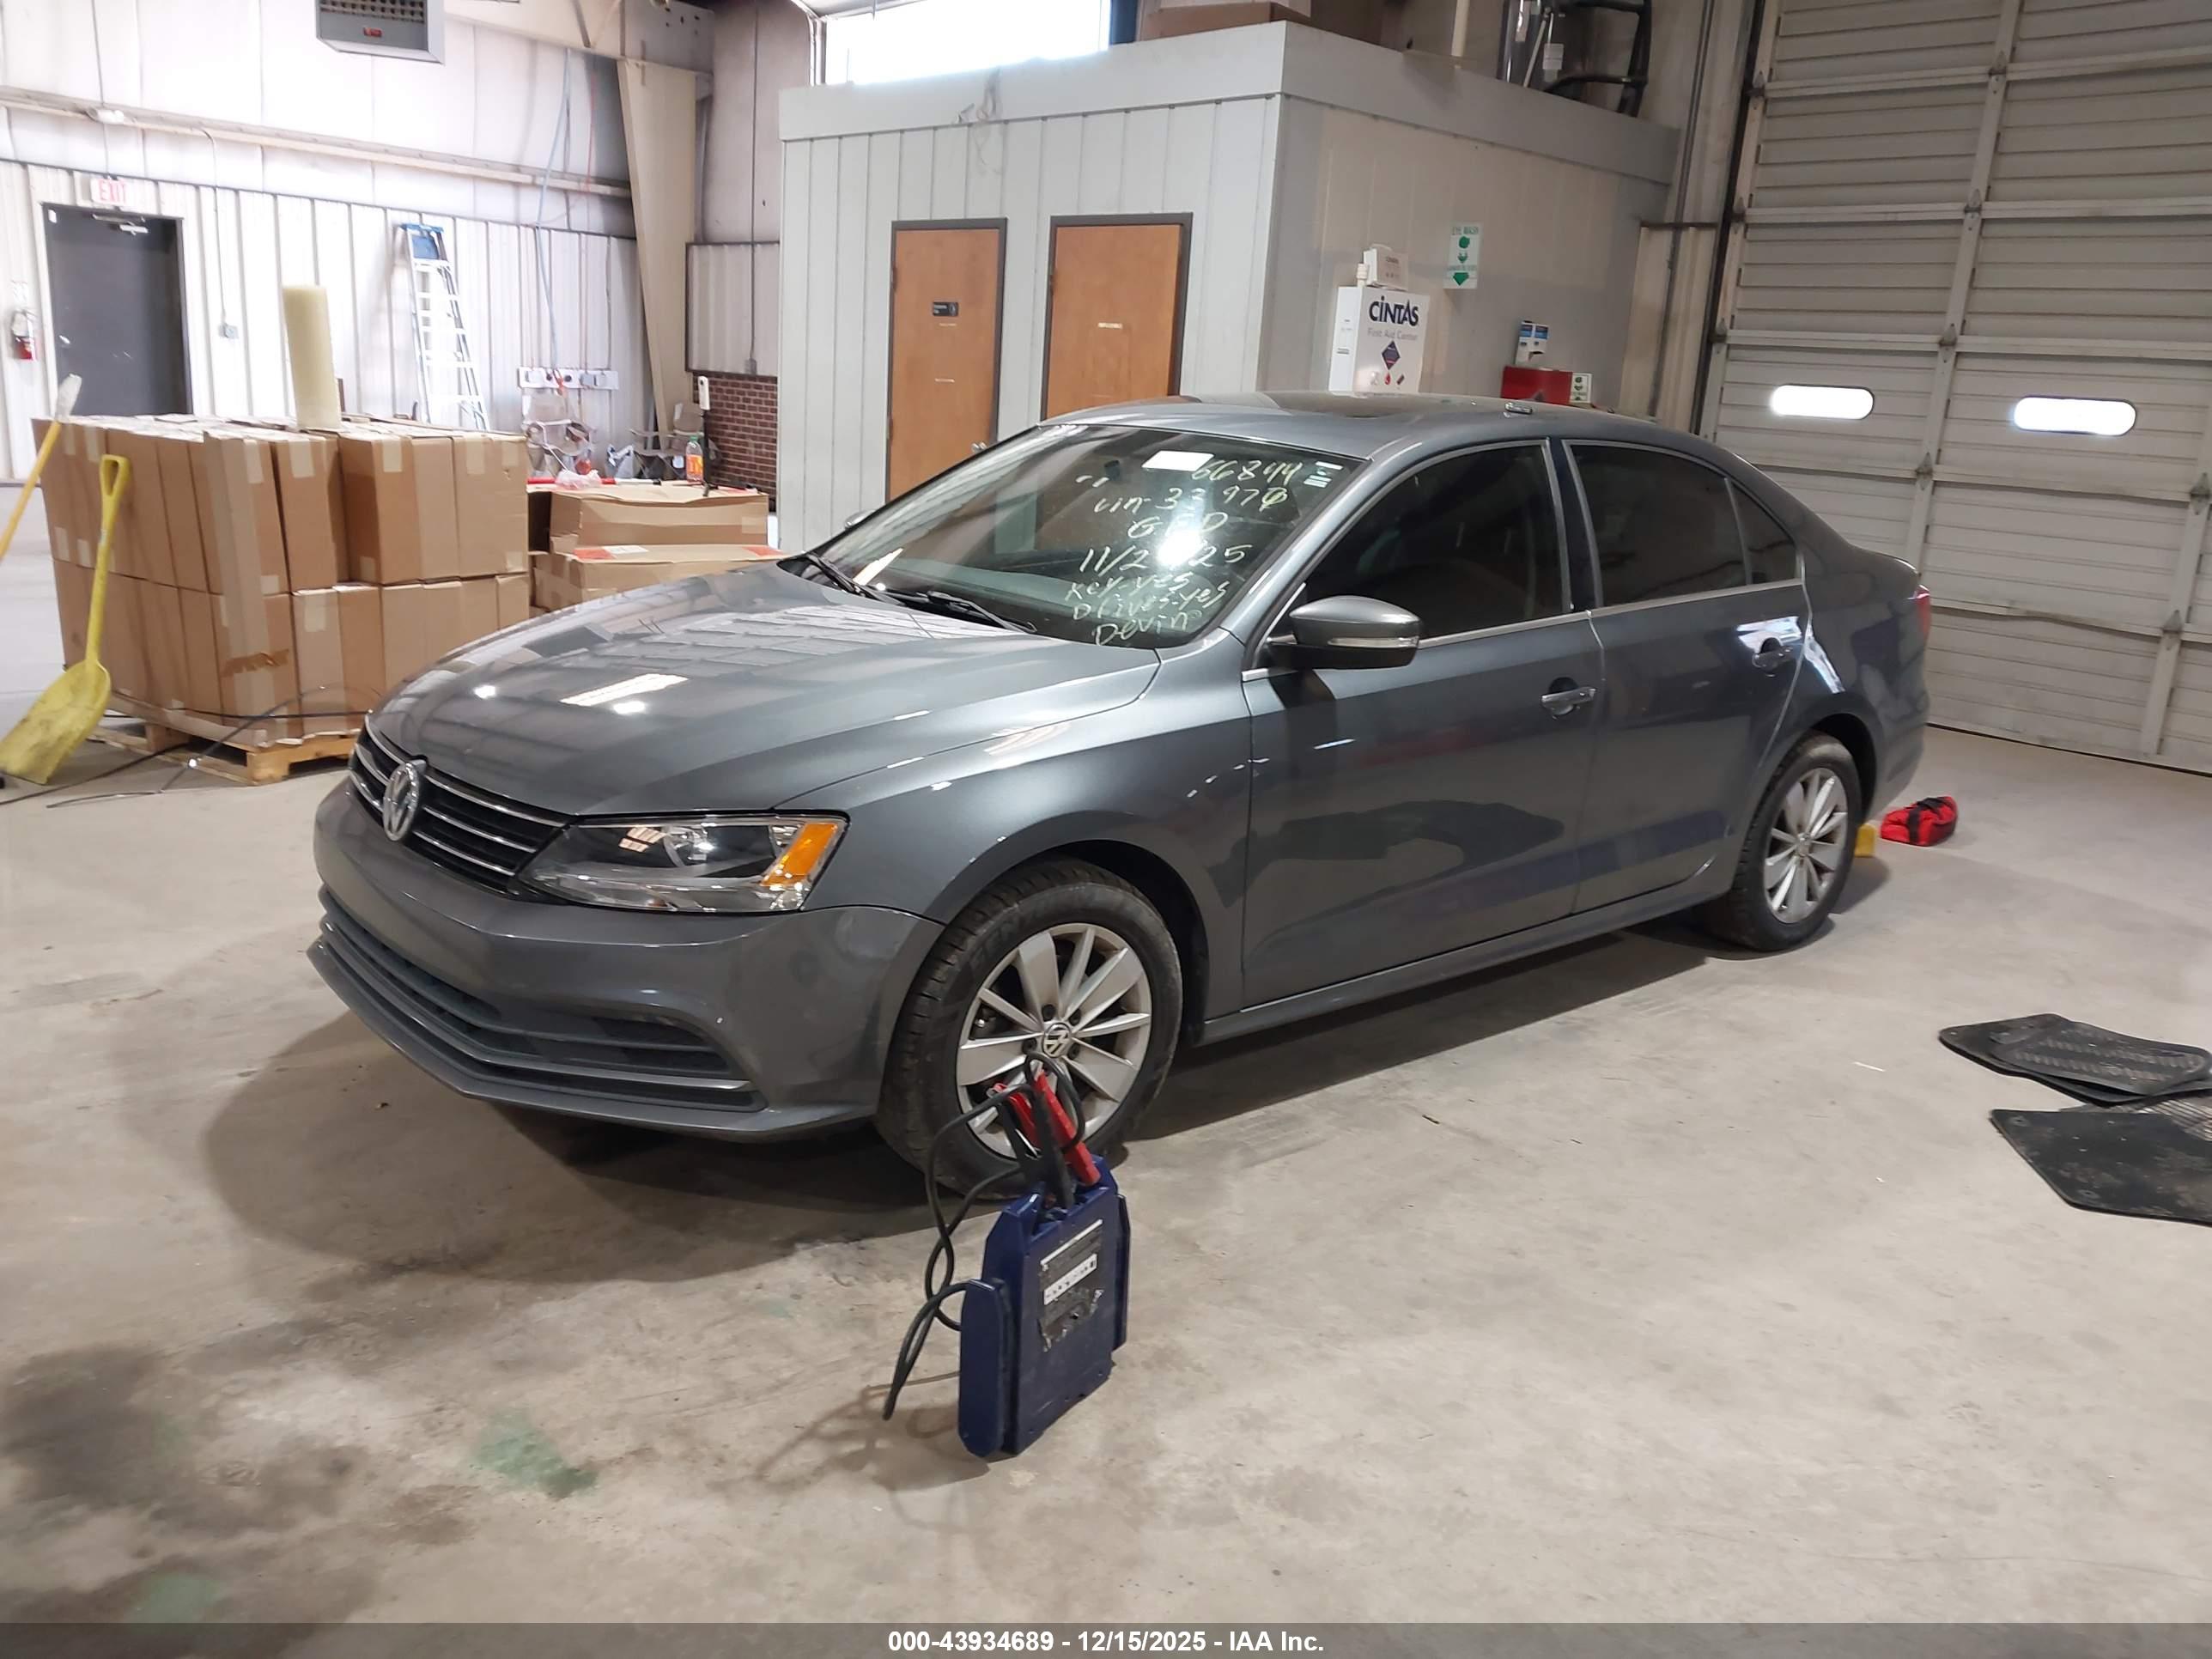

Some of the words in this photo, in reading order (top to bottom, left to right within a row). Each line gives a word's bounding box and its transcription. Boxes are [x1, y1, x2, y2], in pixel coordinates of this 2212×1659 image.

[98, 179, 126, 204] EXIT
[1369, 295, 1419, 326] CINTAS
[1368, 327, 1382, 337] First
[1384, 329, 1395, 339] Aid
[1397, 330, 1419, 341] Center
